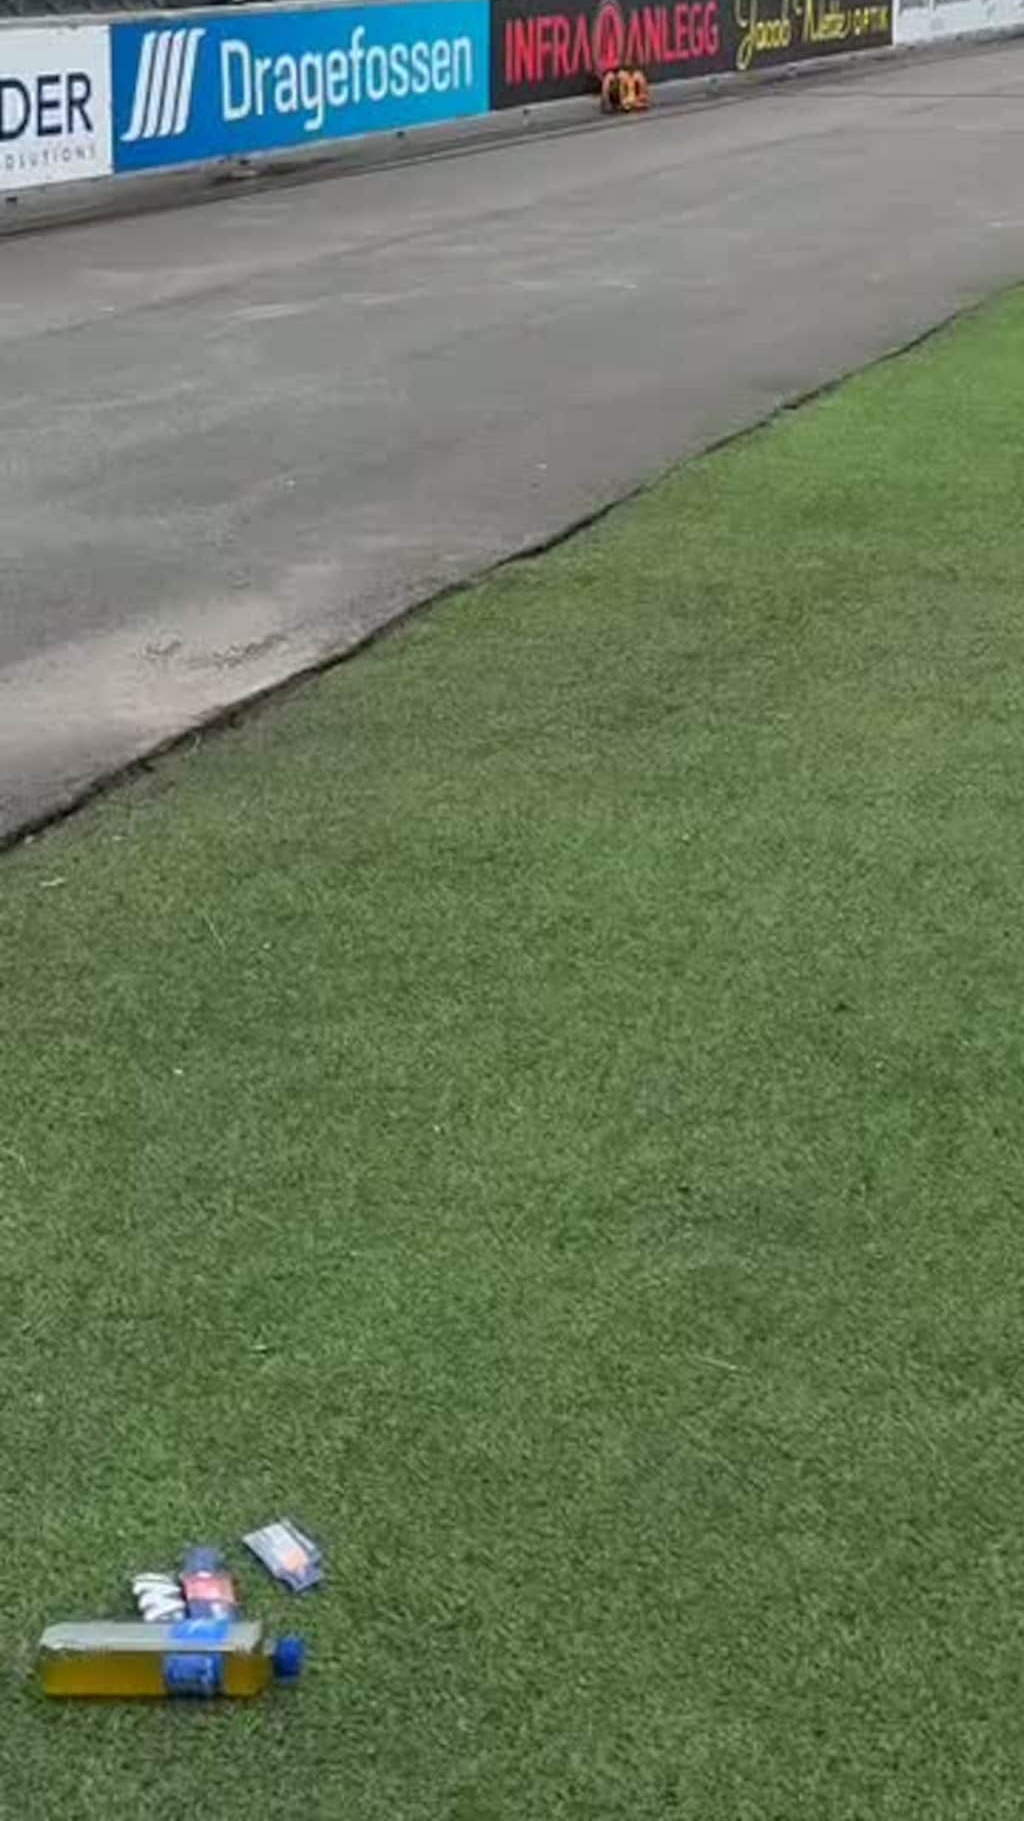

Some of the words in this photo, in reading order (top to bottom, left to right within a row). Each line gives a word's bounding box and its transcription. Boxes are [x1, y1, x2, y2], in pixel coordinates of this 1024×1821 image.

[220, 25, 473, 131] Dragefossen
[505, 14, 590, 85] INFRA
[624, 0, 719, 67] ANLEGG
[0, 71, 94, 142] DER
